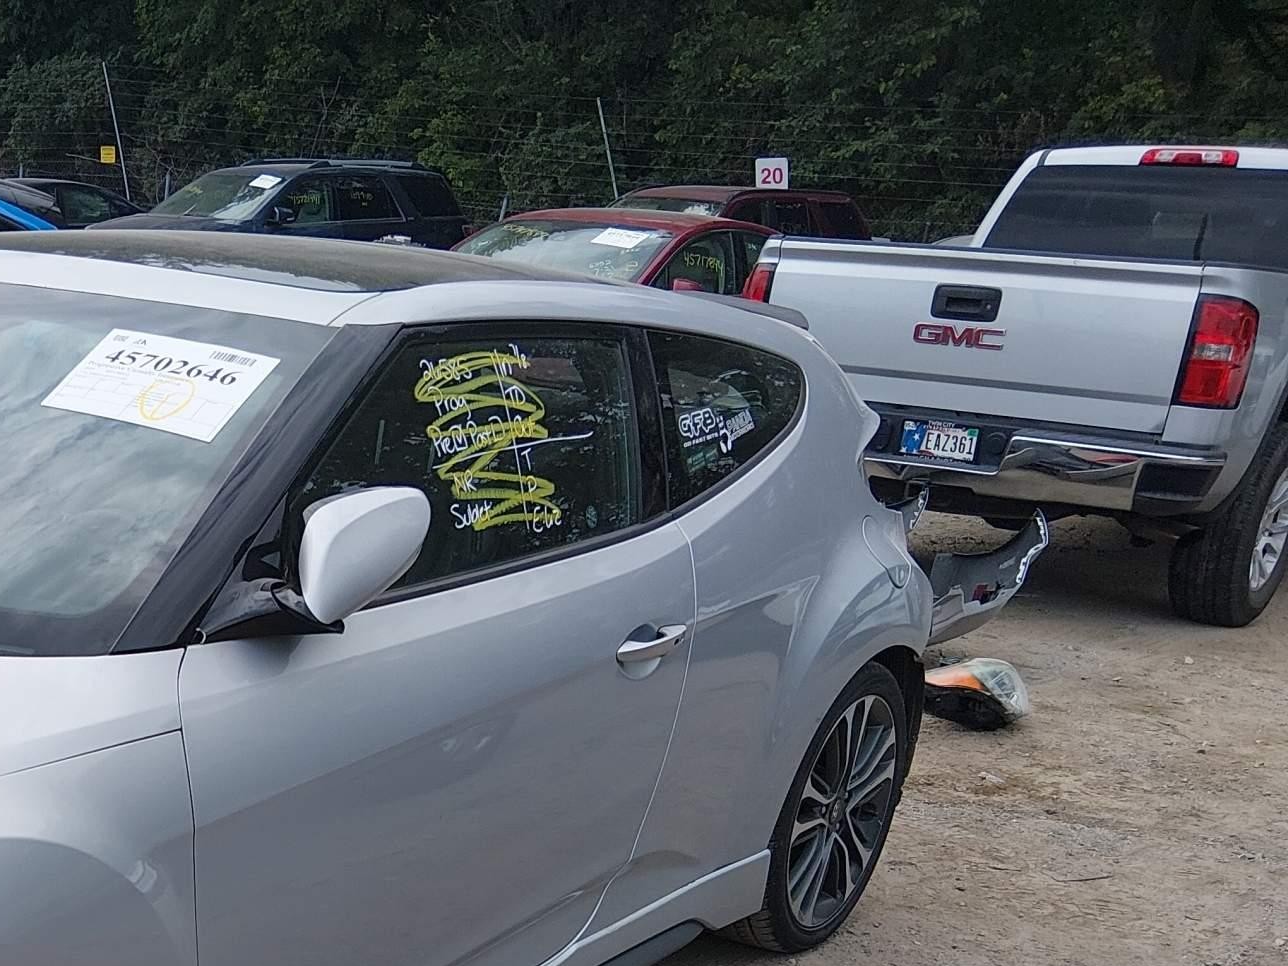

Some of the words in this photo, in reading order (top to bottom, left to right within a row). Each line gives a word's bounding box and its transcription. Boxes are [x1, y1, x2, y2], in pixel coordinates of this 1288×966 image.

[761, 167, 783, 185] 20
[913, 322, 1006, 350] GMC
[104, 349, 241, 386] 45702646
[427, 386, 473, 421] Prog
[679, 408, 716, 438] GFB
[427, 426, 453, 457] Pre
[925, 432, 974, 455] EAZ361
[450, 501, 493, 530] Sublet
